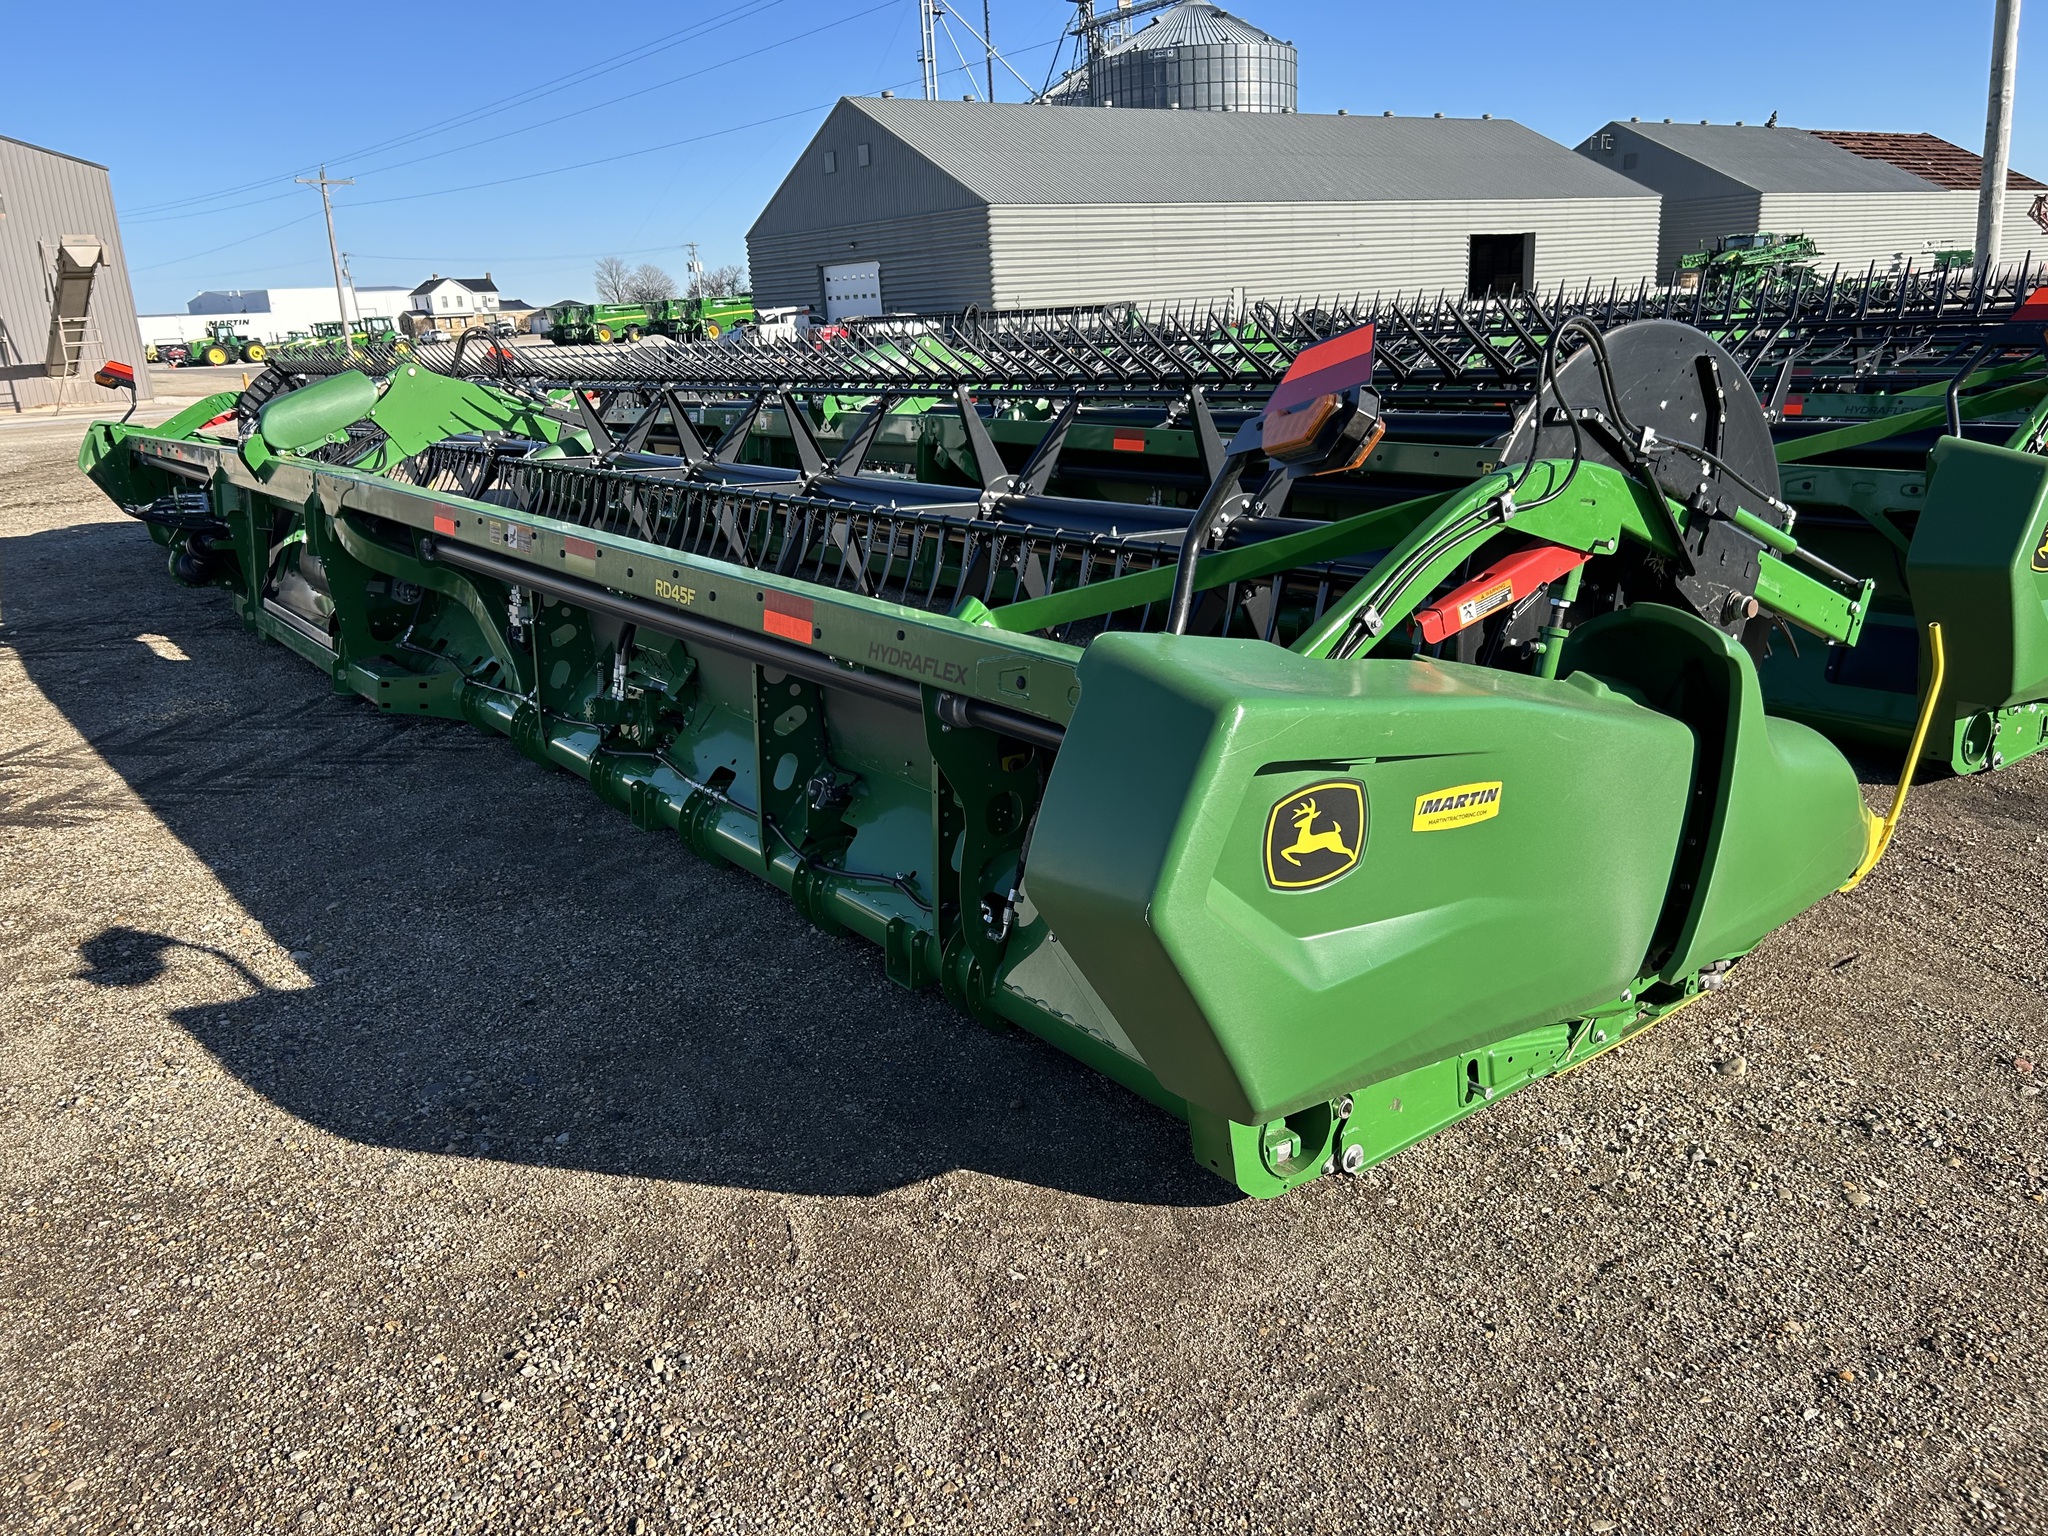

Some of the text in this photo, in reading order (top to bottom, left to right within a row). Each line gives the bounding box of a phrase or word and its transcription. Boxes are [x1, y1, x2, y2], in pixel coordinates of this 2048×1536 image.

[208, 319, 250, 327] MARTIN
[655, 579, 696, 606] RD45F
[868, 641, 969, 686] HYDRAFLEX
[1421, 787, 1499, 815] MARTIN
[1428, 810, 1488, 825] MARTINTRACTORINC.COM
